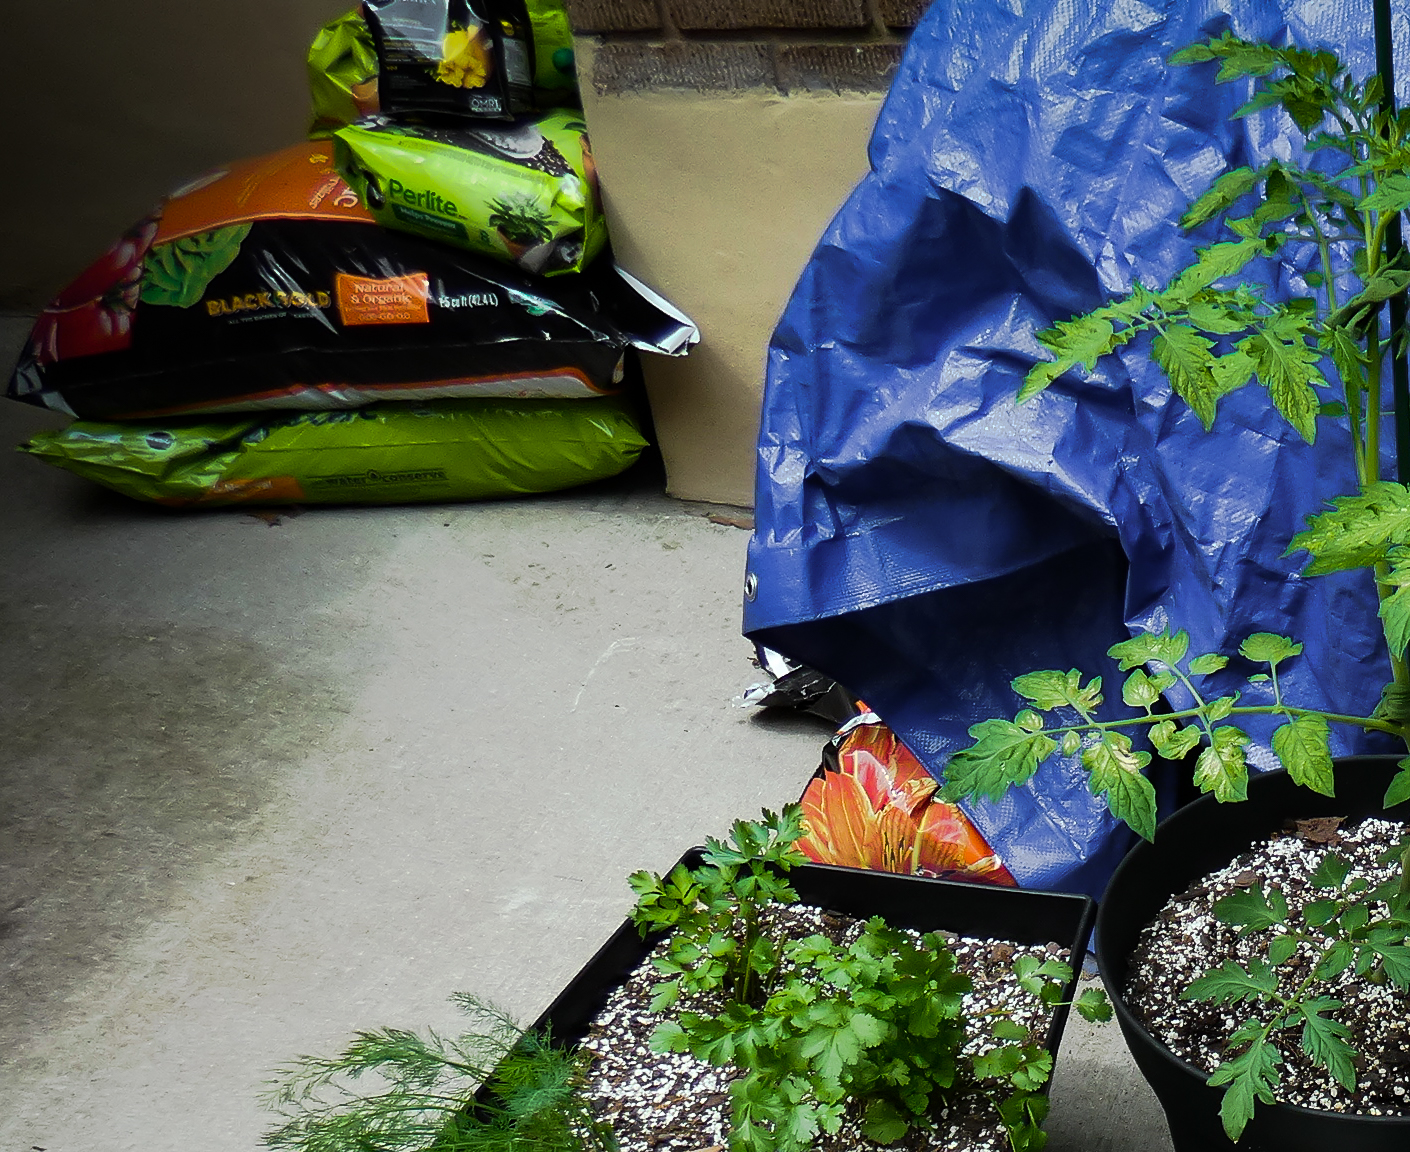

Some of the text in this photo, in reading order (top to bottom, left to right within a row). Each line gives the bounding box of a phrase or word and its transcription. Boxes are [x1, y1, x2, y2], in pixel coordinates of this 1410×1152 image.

[389, 178, 459, 217] Perlite
[354, 282, 404, 293] Natural
[206, 292, 275, 316] BLACK
[362, 294, 413, 306] Organic
